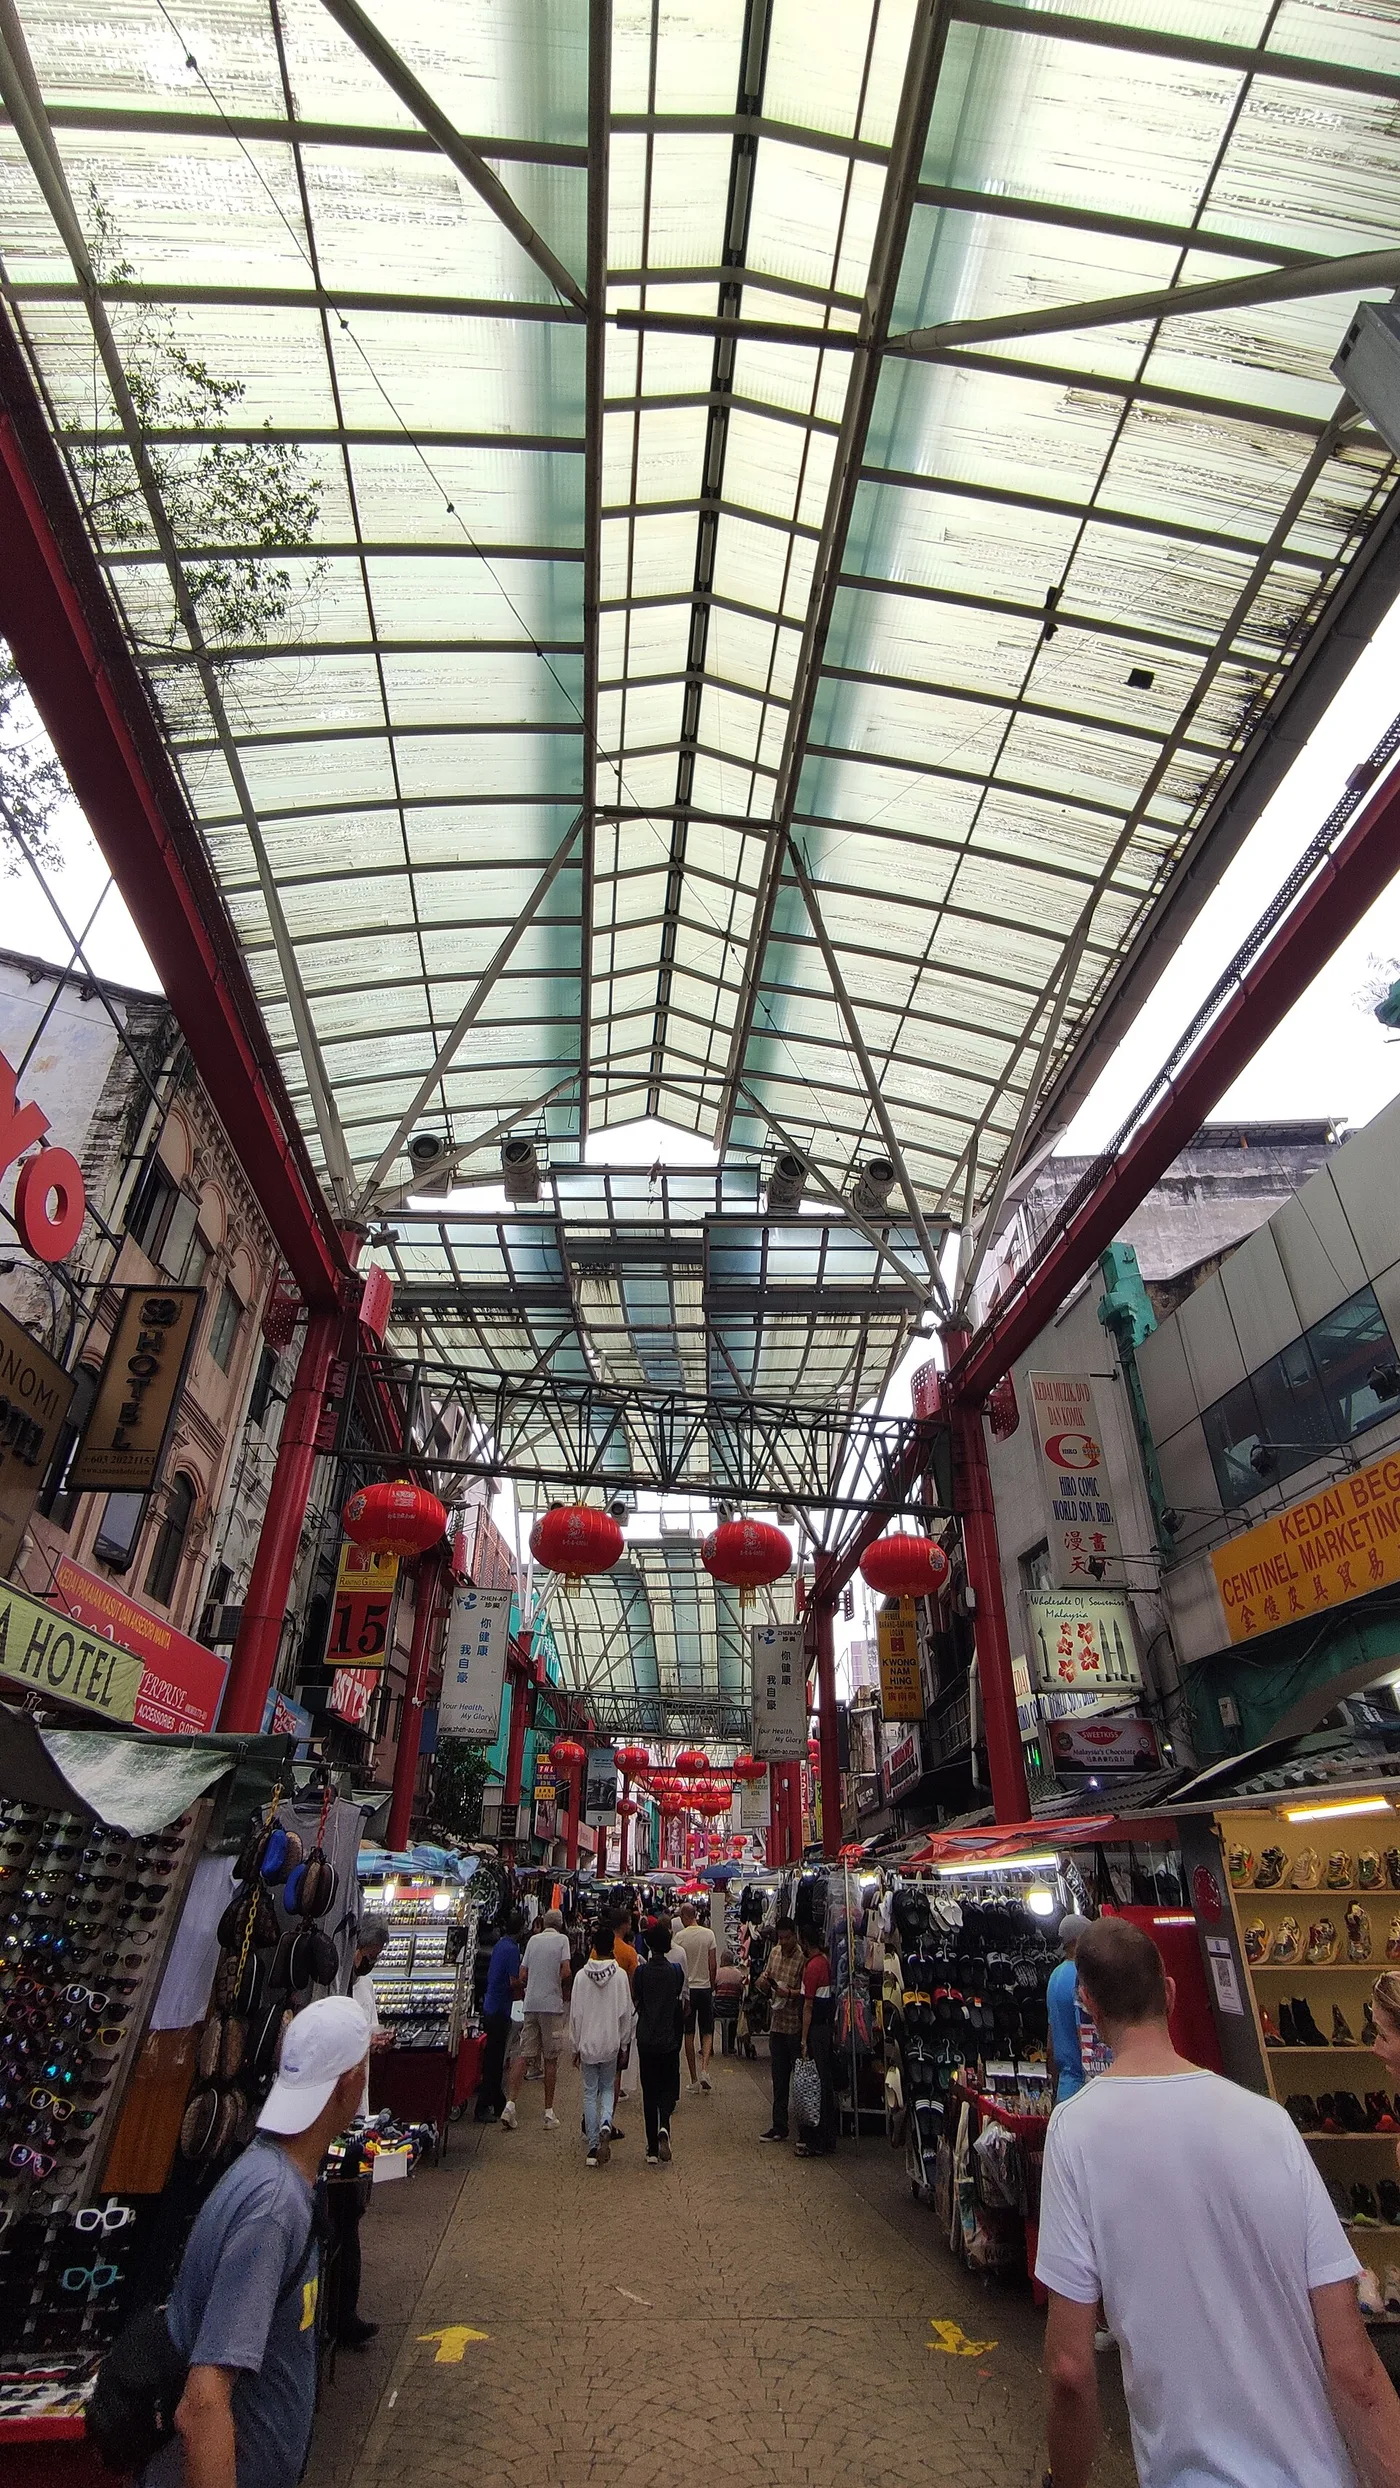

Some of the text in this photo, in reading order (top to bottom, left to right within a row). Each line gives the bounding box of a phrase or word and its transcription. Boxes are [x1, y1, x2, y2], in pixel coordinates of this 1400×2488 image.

[110, 1331, 164, 1449] HOTEL
[1033, 1381, 1053, 1401] KEDAI
[1047, 1406, 1086, 1427] DAN KOMIK
[1058, 1476, 1077, 1497] HIRO
[1052, 1500, 1114, 1523] WORLD SDN. BHD.
[1278, 1461, 1400, 1545] KEDAI BEG
[1222, 1551, 1299, 1607] CENTINEL
[480, 1595, 508, 1603] ZHEN-AO
[1030, 1595, 1072, 1607] Wholesale
[1075, 1597, 1085, 1608] Of
[1045, 1608, 1089, 1622] Malaysia
[330, 1604, 389, 1653] 15
[476, 1617, 492, 1657] 你健康
[19, 1616, 118, 1708] HOTEL
[456, 1643, 472, 1684] 我自豪
[781, 1650, 792, 1686] 你健康
[882, 1658, 917, 1667] KWONG
[890, 1667, 911, 1675] NAM
[890, 1677, 912, 1685] HING
[766, 1674, 777, 1711] 我自豪
[442, 1702, 485, 1712] Your Health,
[461, 1712, 472, 1721] My
[473, 1713, 493, 1722] Glory
[1081, 1731, 1119, 1739] SWEETKISS
